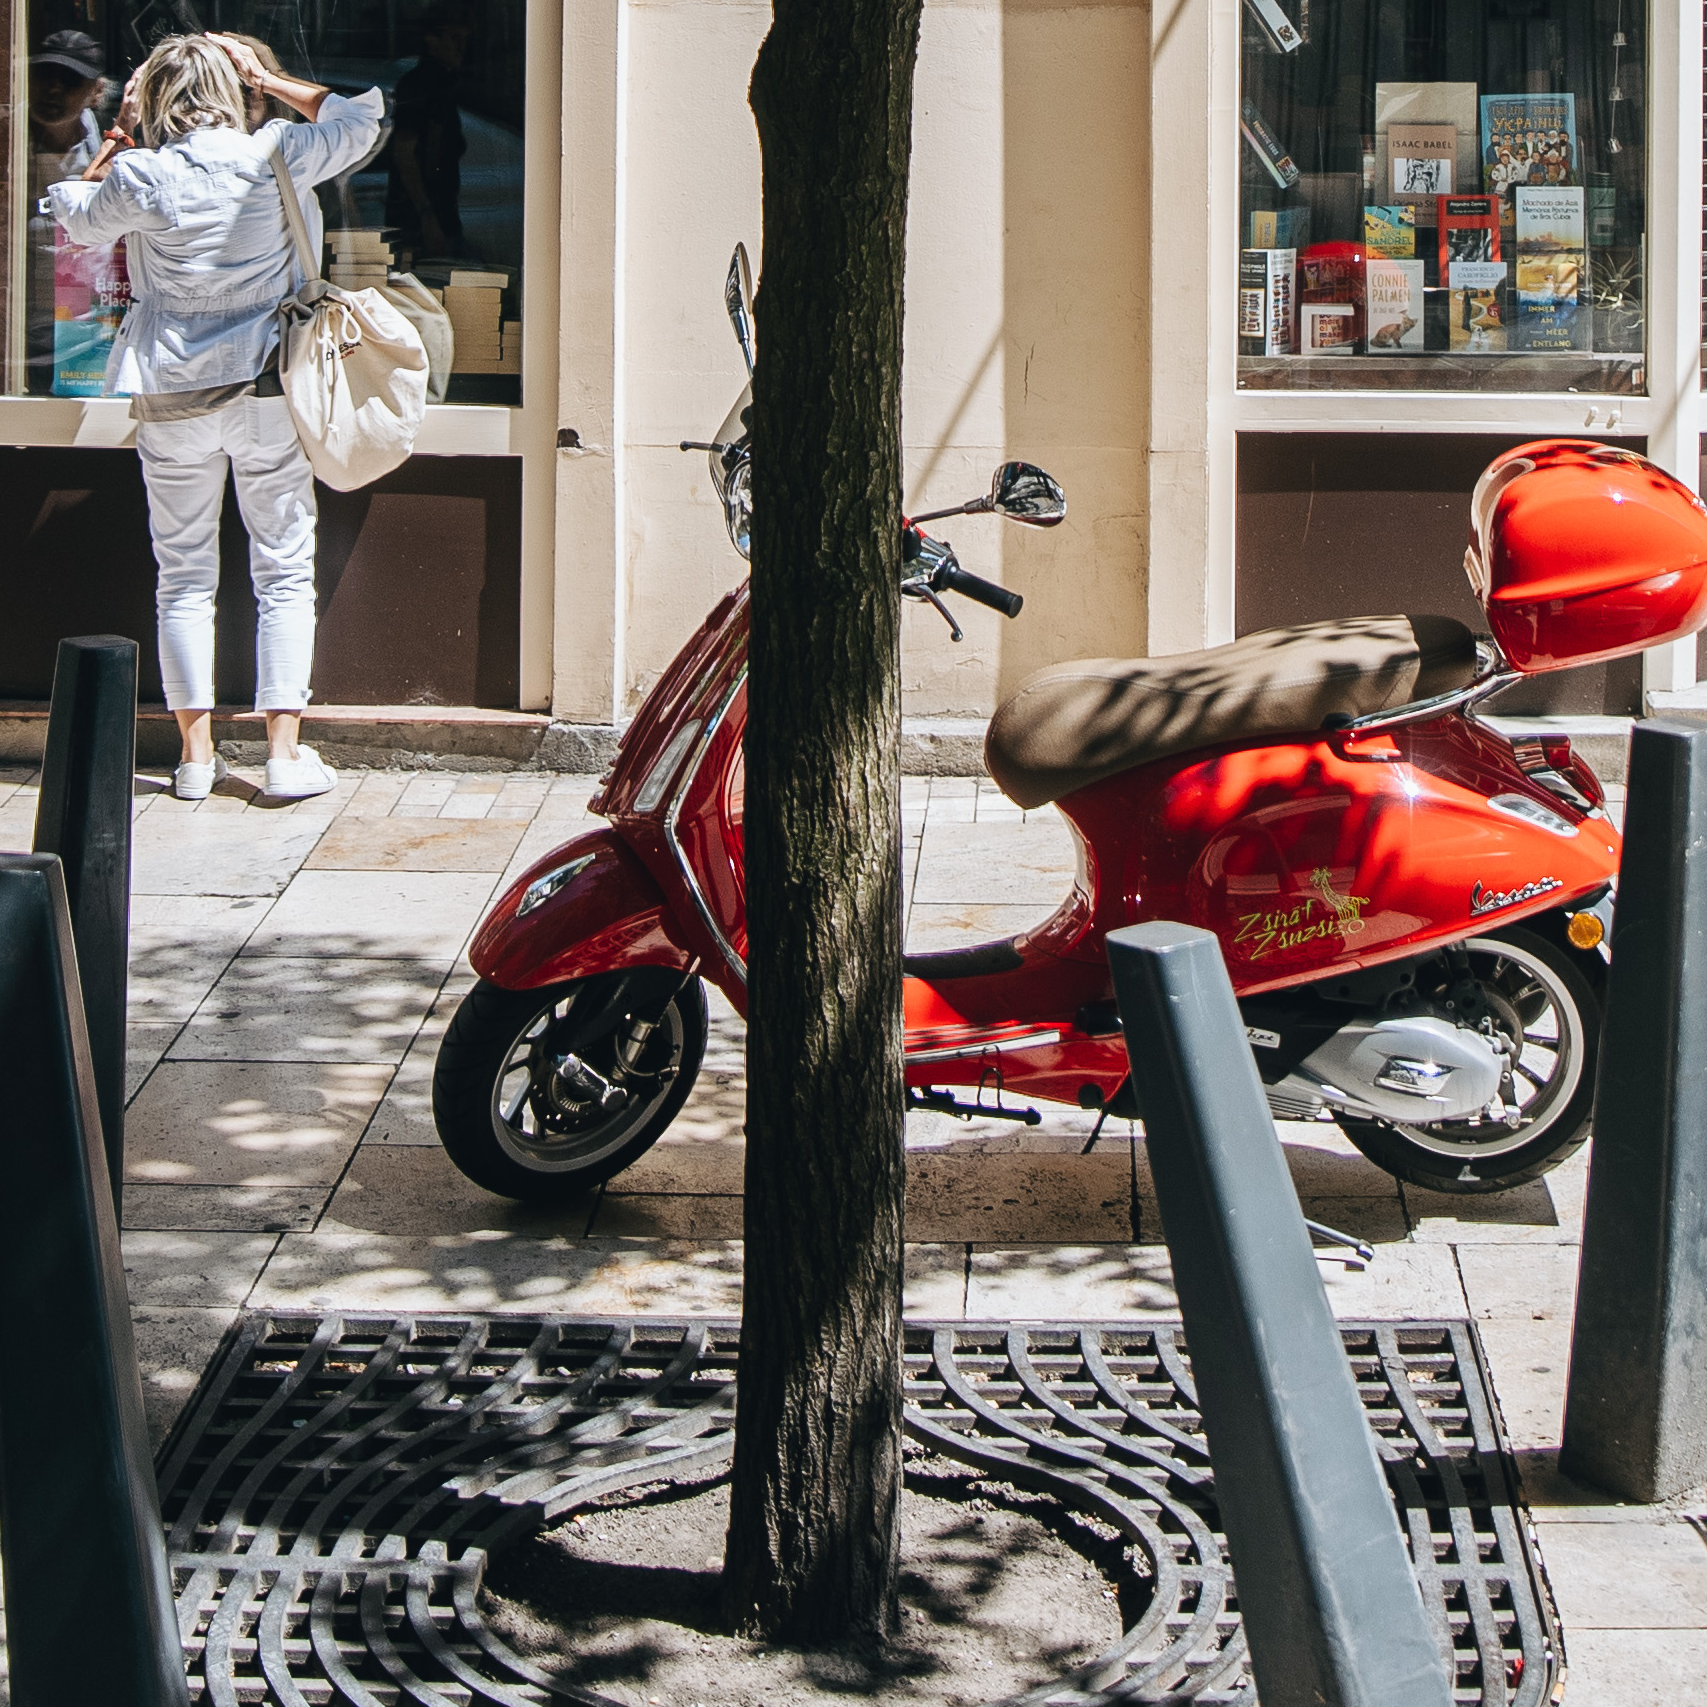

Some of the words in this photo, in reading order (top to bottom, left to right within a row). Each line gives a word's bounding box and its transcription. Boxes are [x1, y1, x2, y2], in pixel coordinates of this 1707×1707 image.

[1392, 139, 1420, 150] ISAAC
[1423, 139, 1453, 150] BABEL
[95, 277, 132, 296] Happ
[1371, 273, 1409, 288] CONNIE
[1372, 288, 1411, 303] PALMEN
[1546, 328, 1569, 336] MEER
[1532, 339, 1572, 348] ENTLANG
[1249, 914, 1338, 961] Zsuzsi
